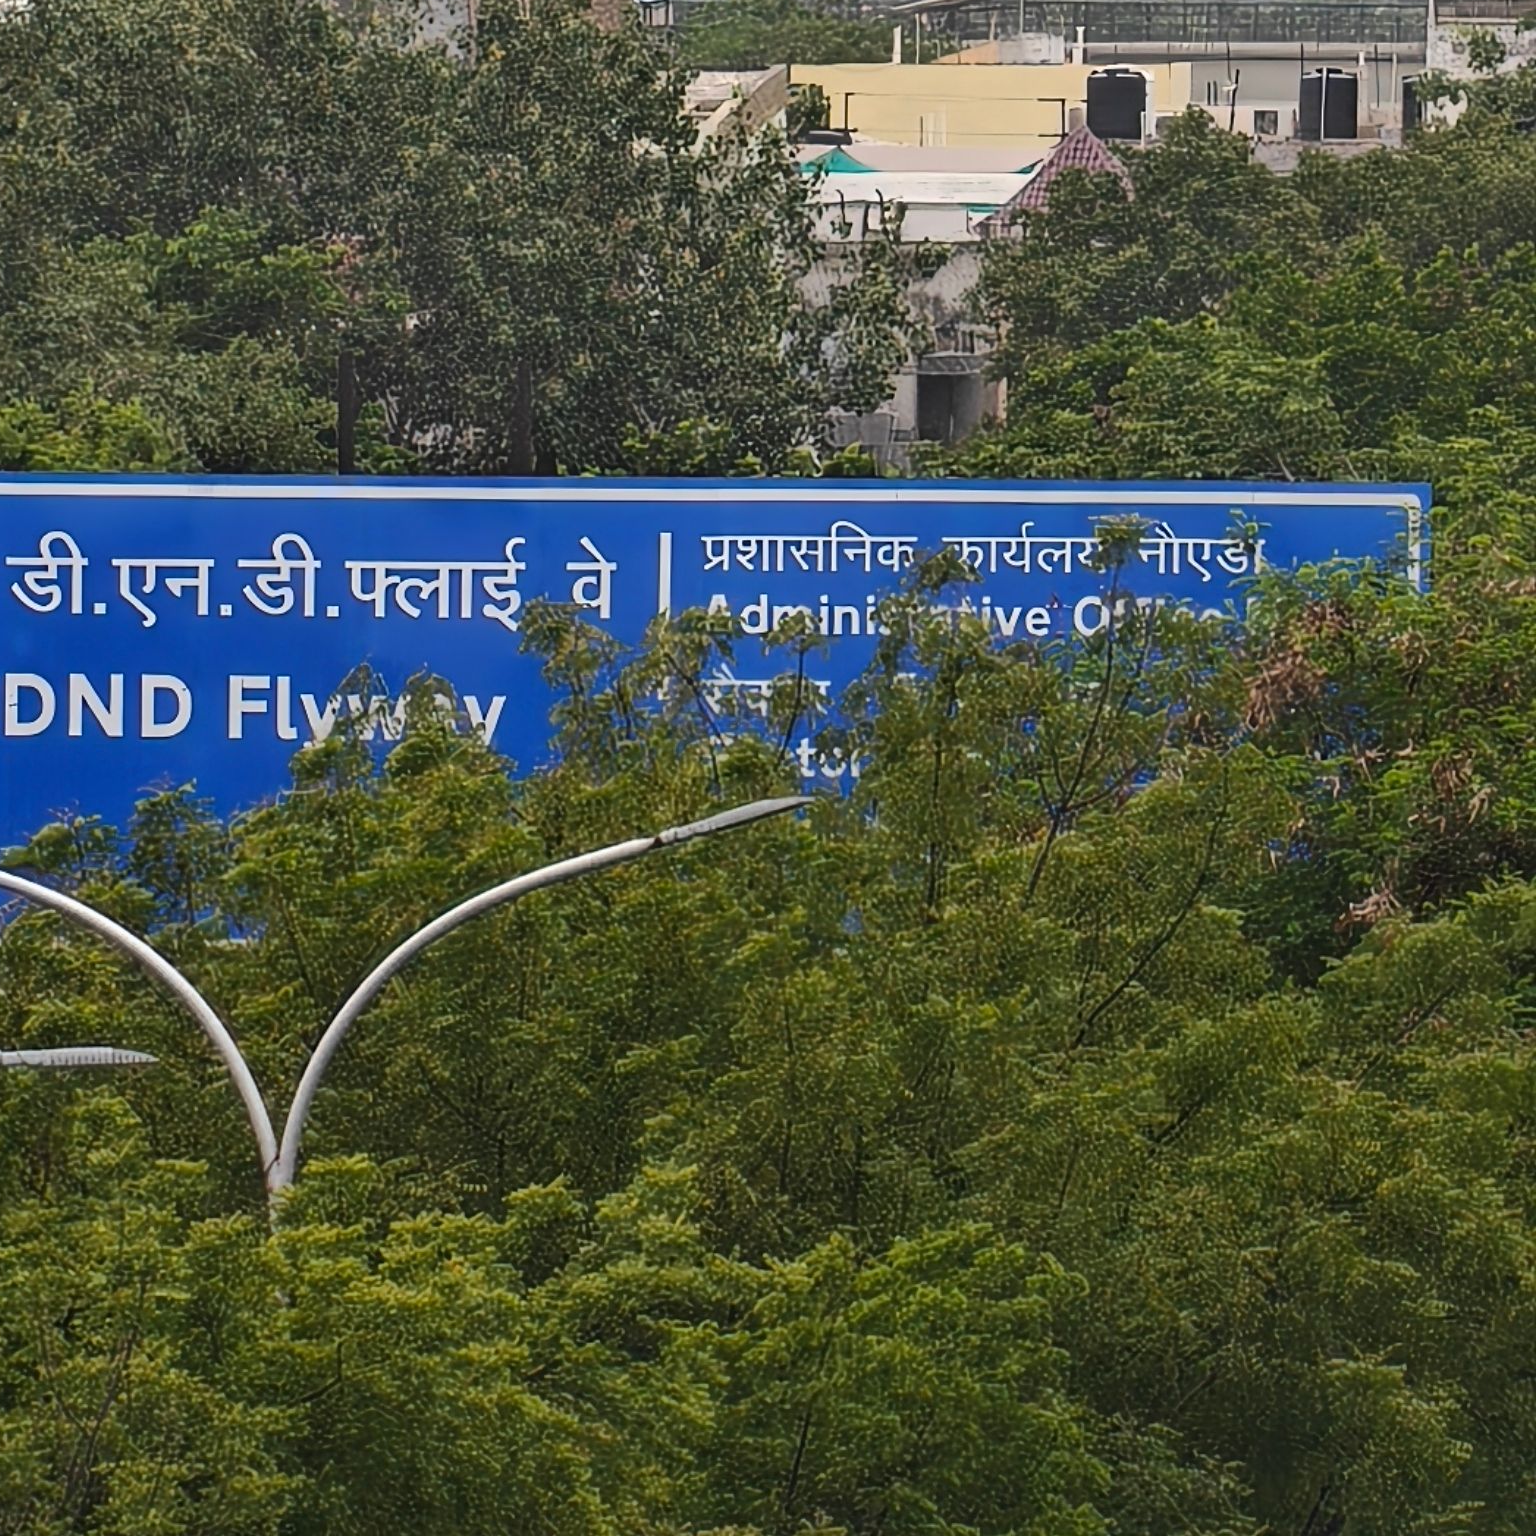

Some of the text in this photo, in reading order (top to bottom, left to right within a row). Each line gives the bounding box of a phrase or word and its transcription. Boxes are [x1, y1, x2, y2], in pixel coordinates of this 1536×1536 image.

[566, 537, 617, 619] वे
[700, 520, 918, 573] प्रशासनिक
[4, 673, 193, 738] DND
